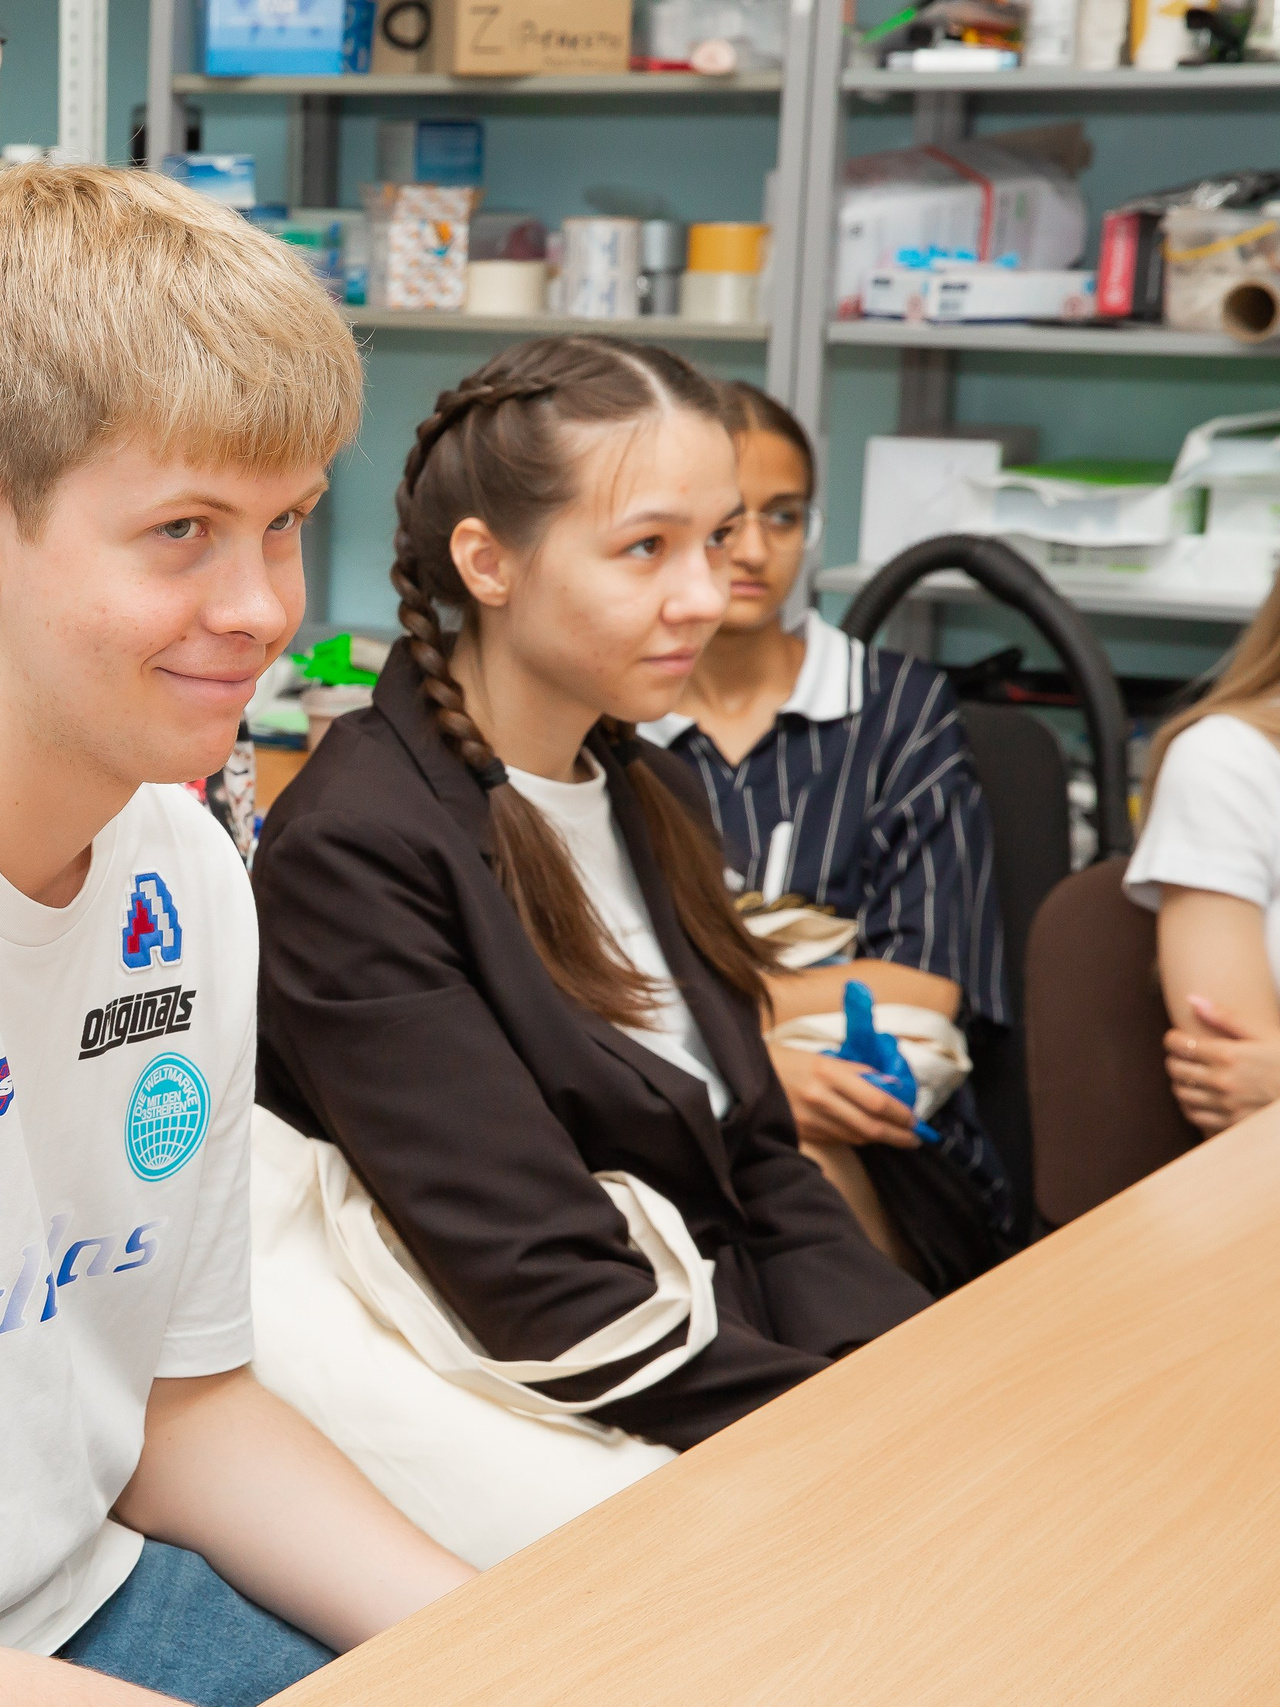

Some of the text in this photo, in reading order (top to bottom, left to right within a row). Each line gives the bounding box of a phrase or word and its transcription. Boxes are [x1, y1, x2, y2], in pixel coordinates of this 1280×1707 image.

[144, 1067, 198, 1108] WELTMARKE
[146, 1090, 182, 1108] MIT DEN
